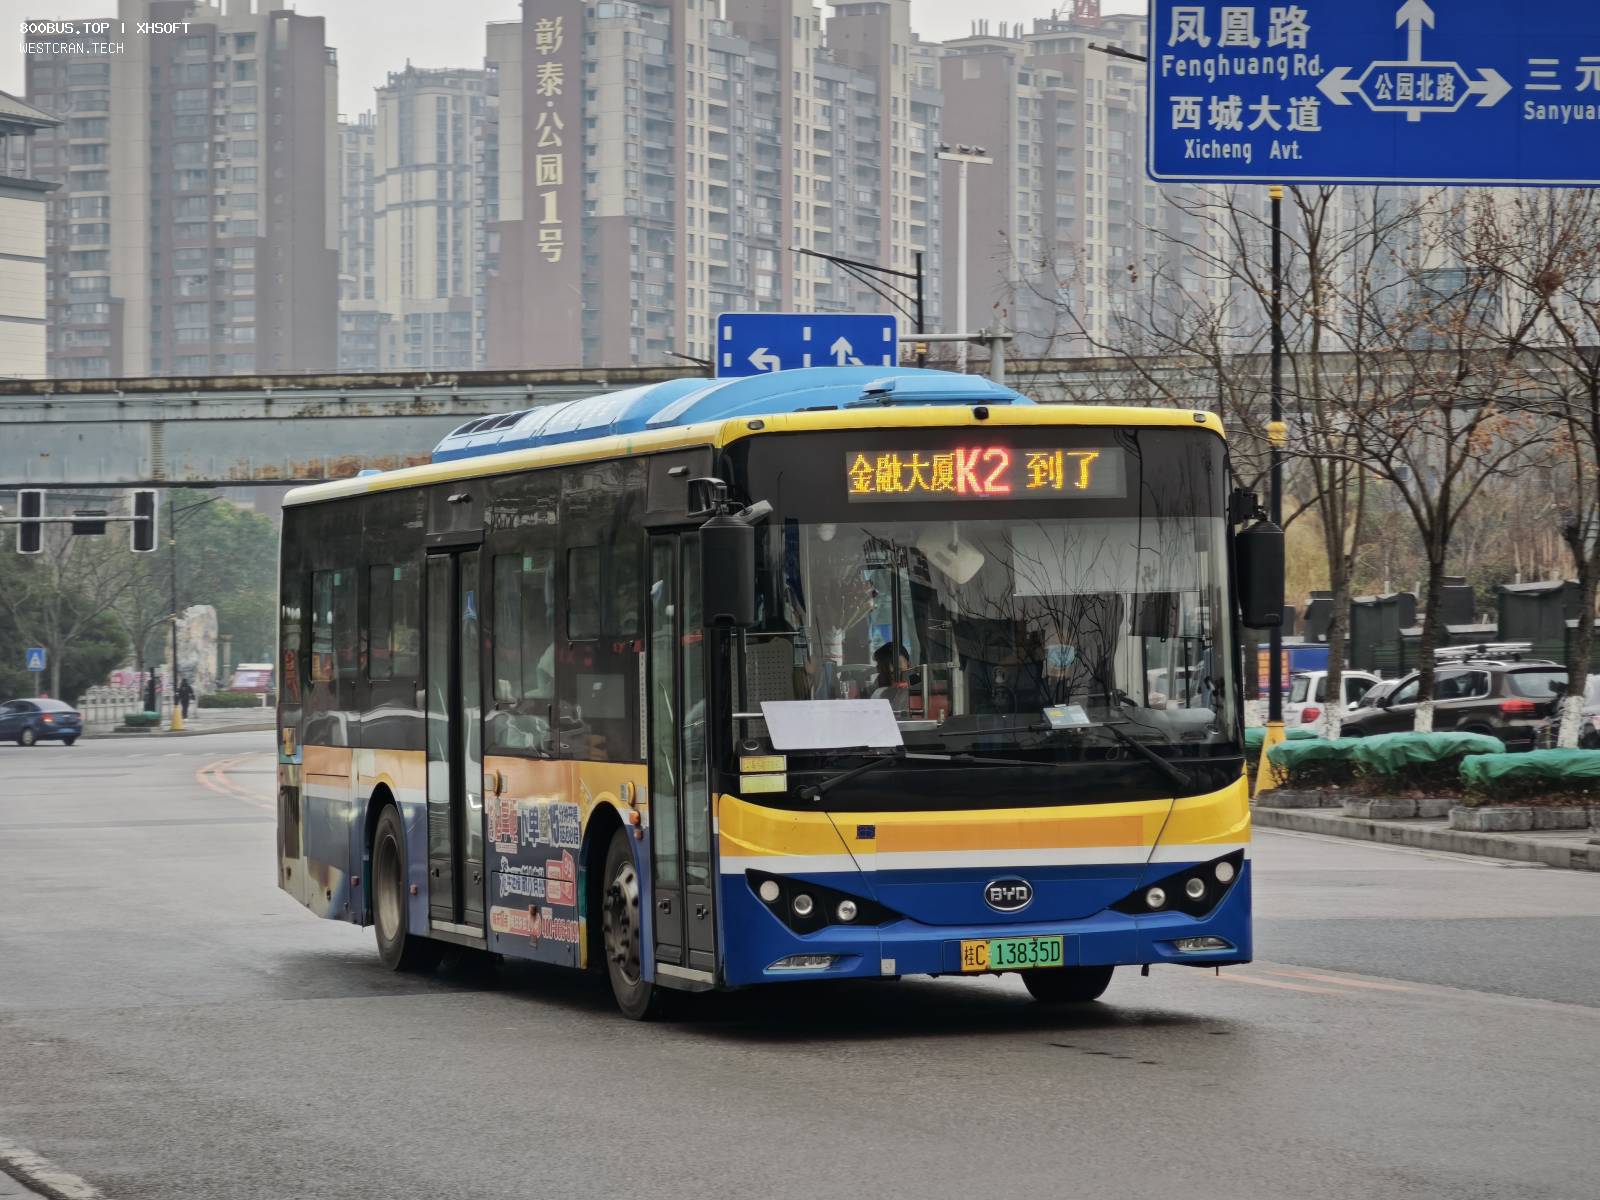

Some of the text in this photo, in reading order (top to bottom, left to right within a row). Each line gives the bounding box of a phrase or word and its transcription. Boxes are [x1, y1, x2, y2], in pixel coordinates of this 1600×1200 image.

[1167, 4, 1311, 49] 凤凰路
[1161, 53, 1325, 83] Fenghuang Rd.
[1374, 72, 1455, 102] 公园北路
[1169, 94, 1322, 132] 西城大道
[1523, 100, 1600, 125] Sanyua
[1184, 138, 1303, 164] Xicheng Avt.
[849, 448, 1100, 493] 金融大厦 K2 到了
[989, 886, 1028, 901] BYD
[996, 941, 1061, 965] 13835D
